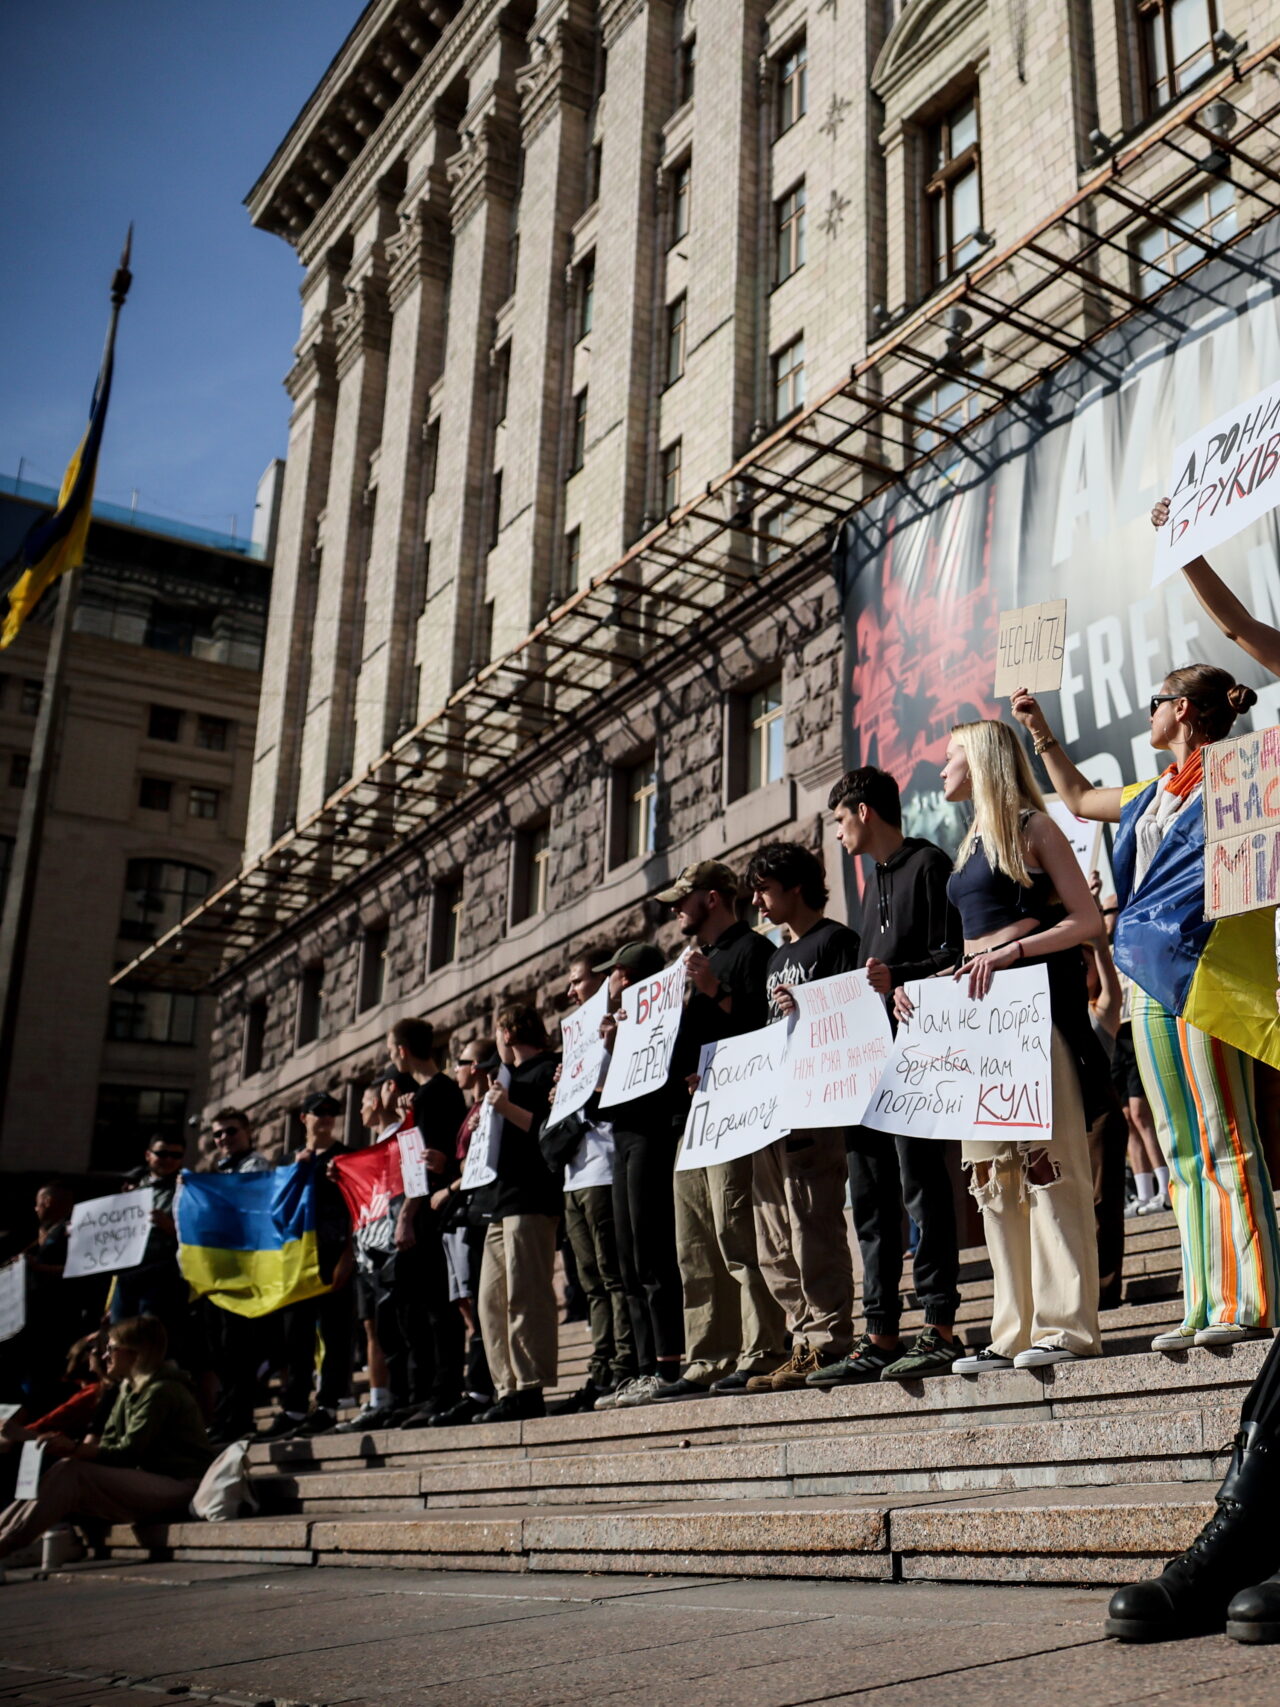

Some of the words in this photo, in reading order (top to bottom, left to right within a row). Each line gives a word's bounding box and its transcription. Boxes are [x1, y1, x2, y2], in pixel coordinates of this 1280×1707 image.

[906, 984, 952, 1034] Нам
[958, 1008, 981, 1030] не
[810, 1012, 849, 1048] ВОРОГА
[793, 1056, 815, 1081] НІЖ
[821, 1049, 841, 1073] РУКА
[846, 1045, 863, 1068] ЯКА
[1021, 1033, 1048, 1061] на
[979, 1055, 1013, 1077] нам
[823, 1074, 857, 1103] АРМІЇ
[875, 1080, 964, 1124] потрібні
[686, 1096, 778, 1149] Перемогу
[77, 1206, 145, 1231] ДОСИТЬ
[83, 1244, 127, 1270] ЗСУ
